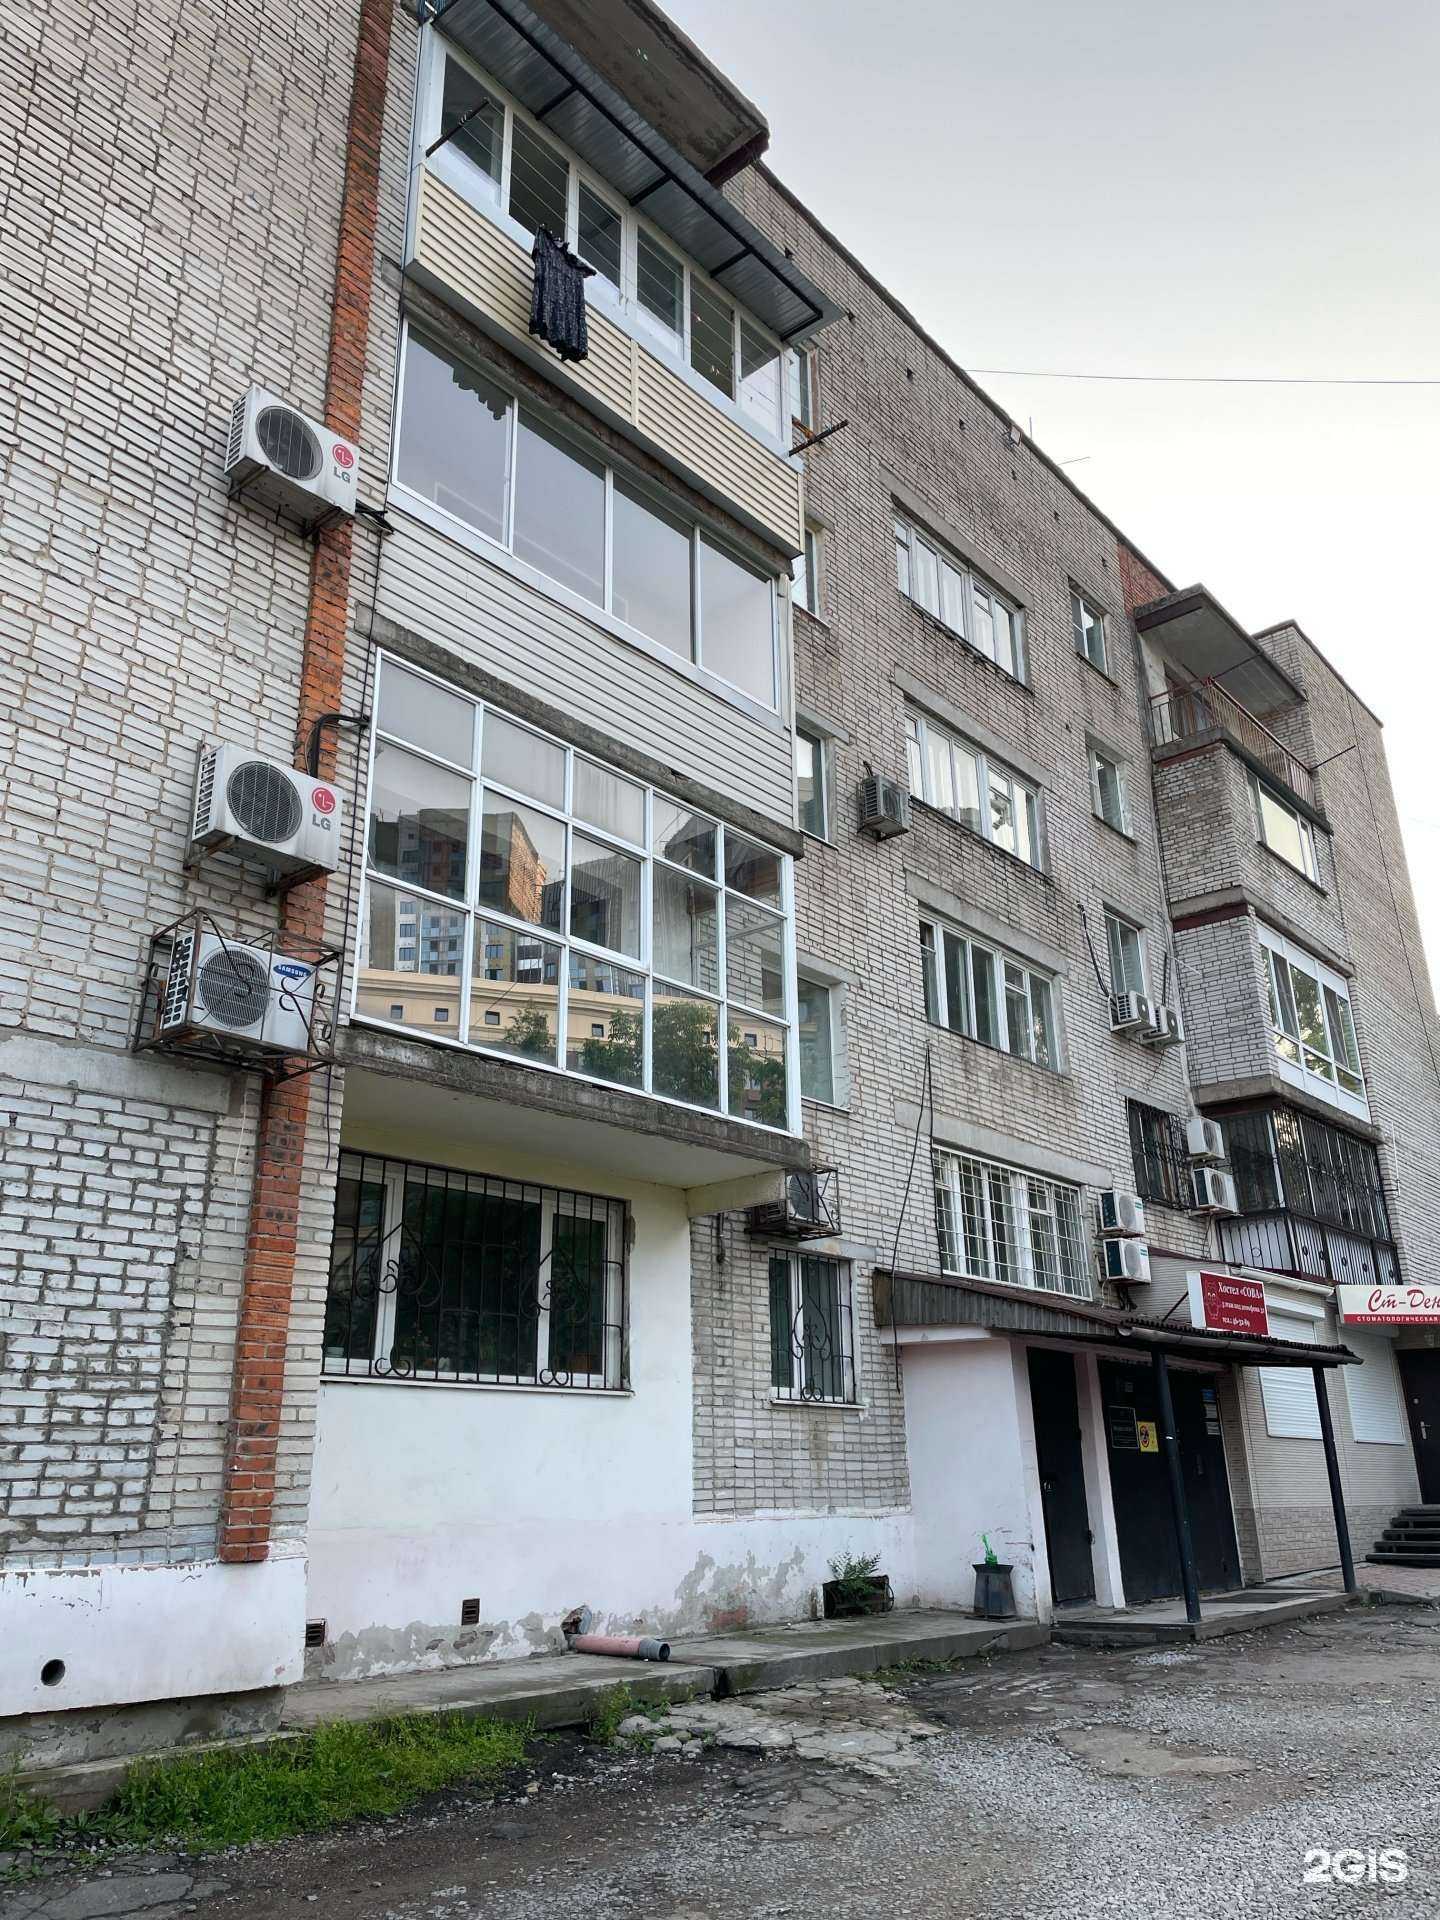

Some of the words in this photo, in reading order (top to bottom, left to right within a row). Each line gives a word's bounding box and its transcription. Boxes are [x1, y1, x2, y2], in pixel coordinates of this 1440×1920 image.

[334, 466, 351, 484] LG
[312, 814, 331, 831] LG
[278, 963, 308, 977] SAMSUNG
[1218, 1281, 1240, 1296] Хостел
